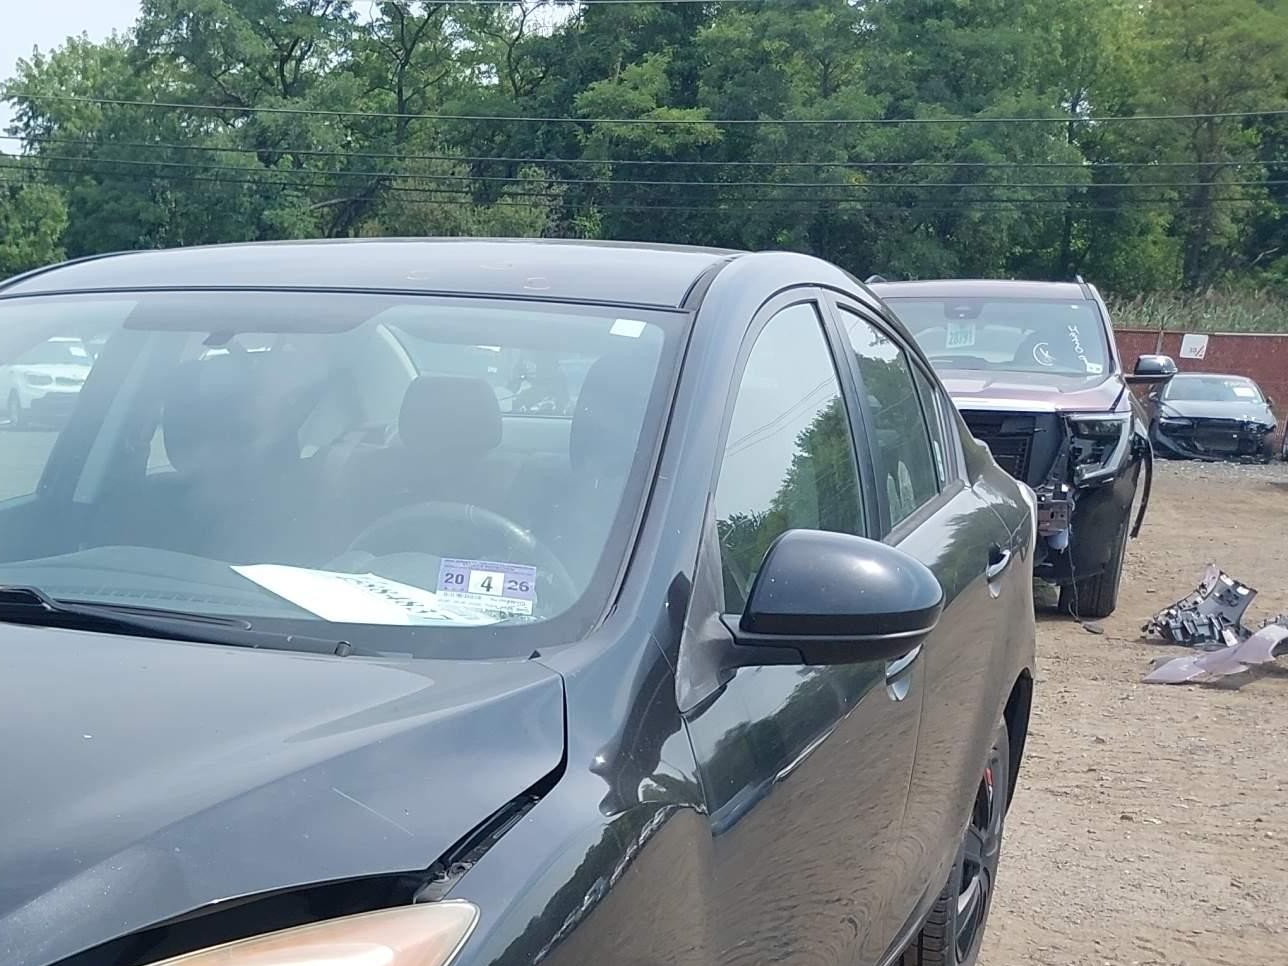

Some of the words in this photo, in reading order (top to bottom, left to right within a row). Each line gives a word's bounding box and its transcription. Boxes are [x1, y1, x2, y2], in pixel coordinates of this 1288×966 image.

[444, 572, 465, 585] 20
[480, 576, 494, 592] 4
[507, 579, 530, 592] 26
